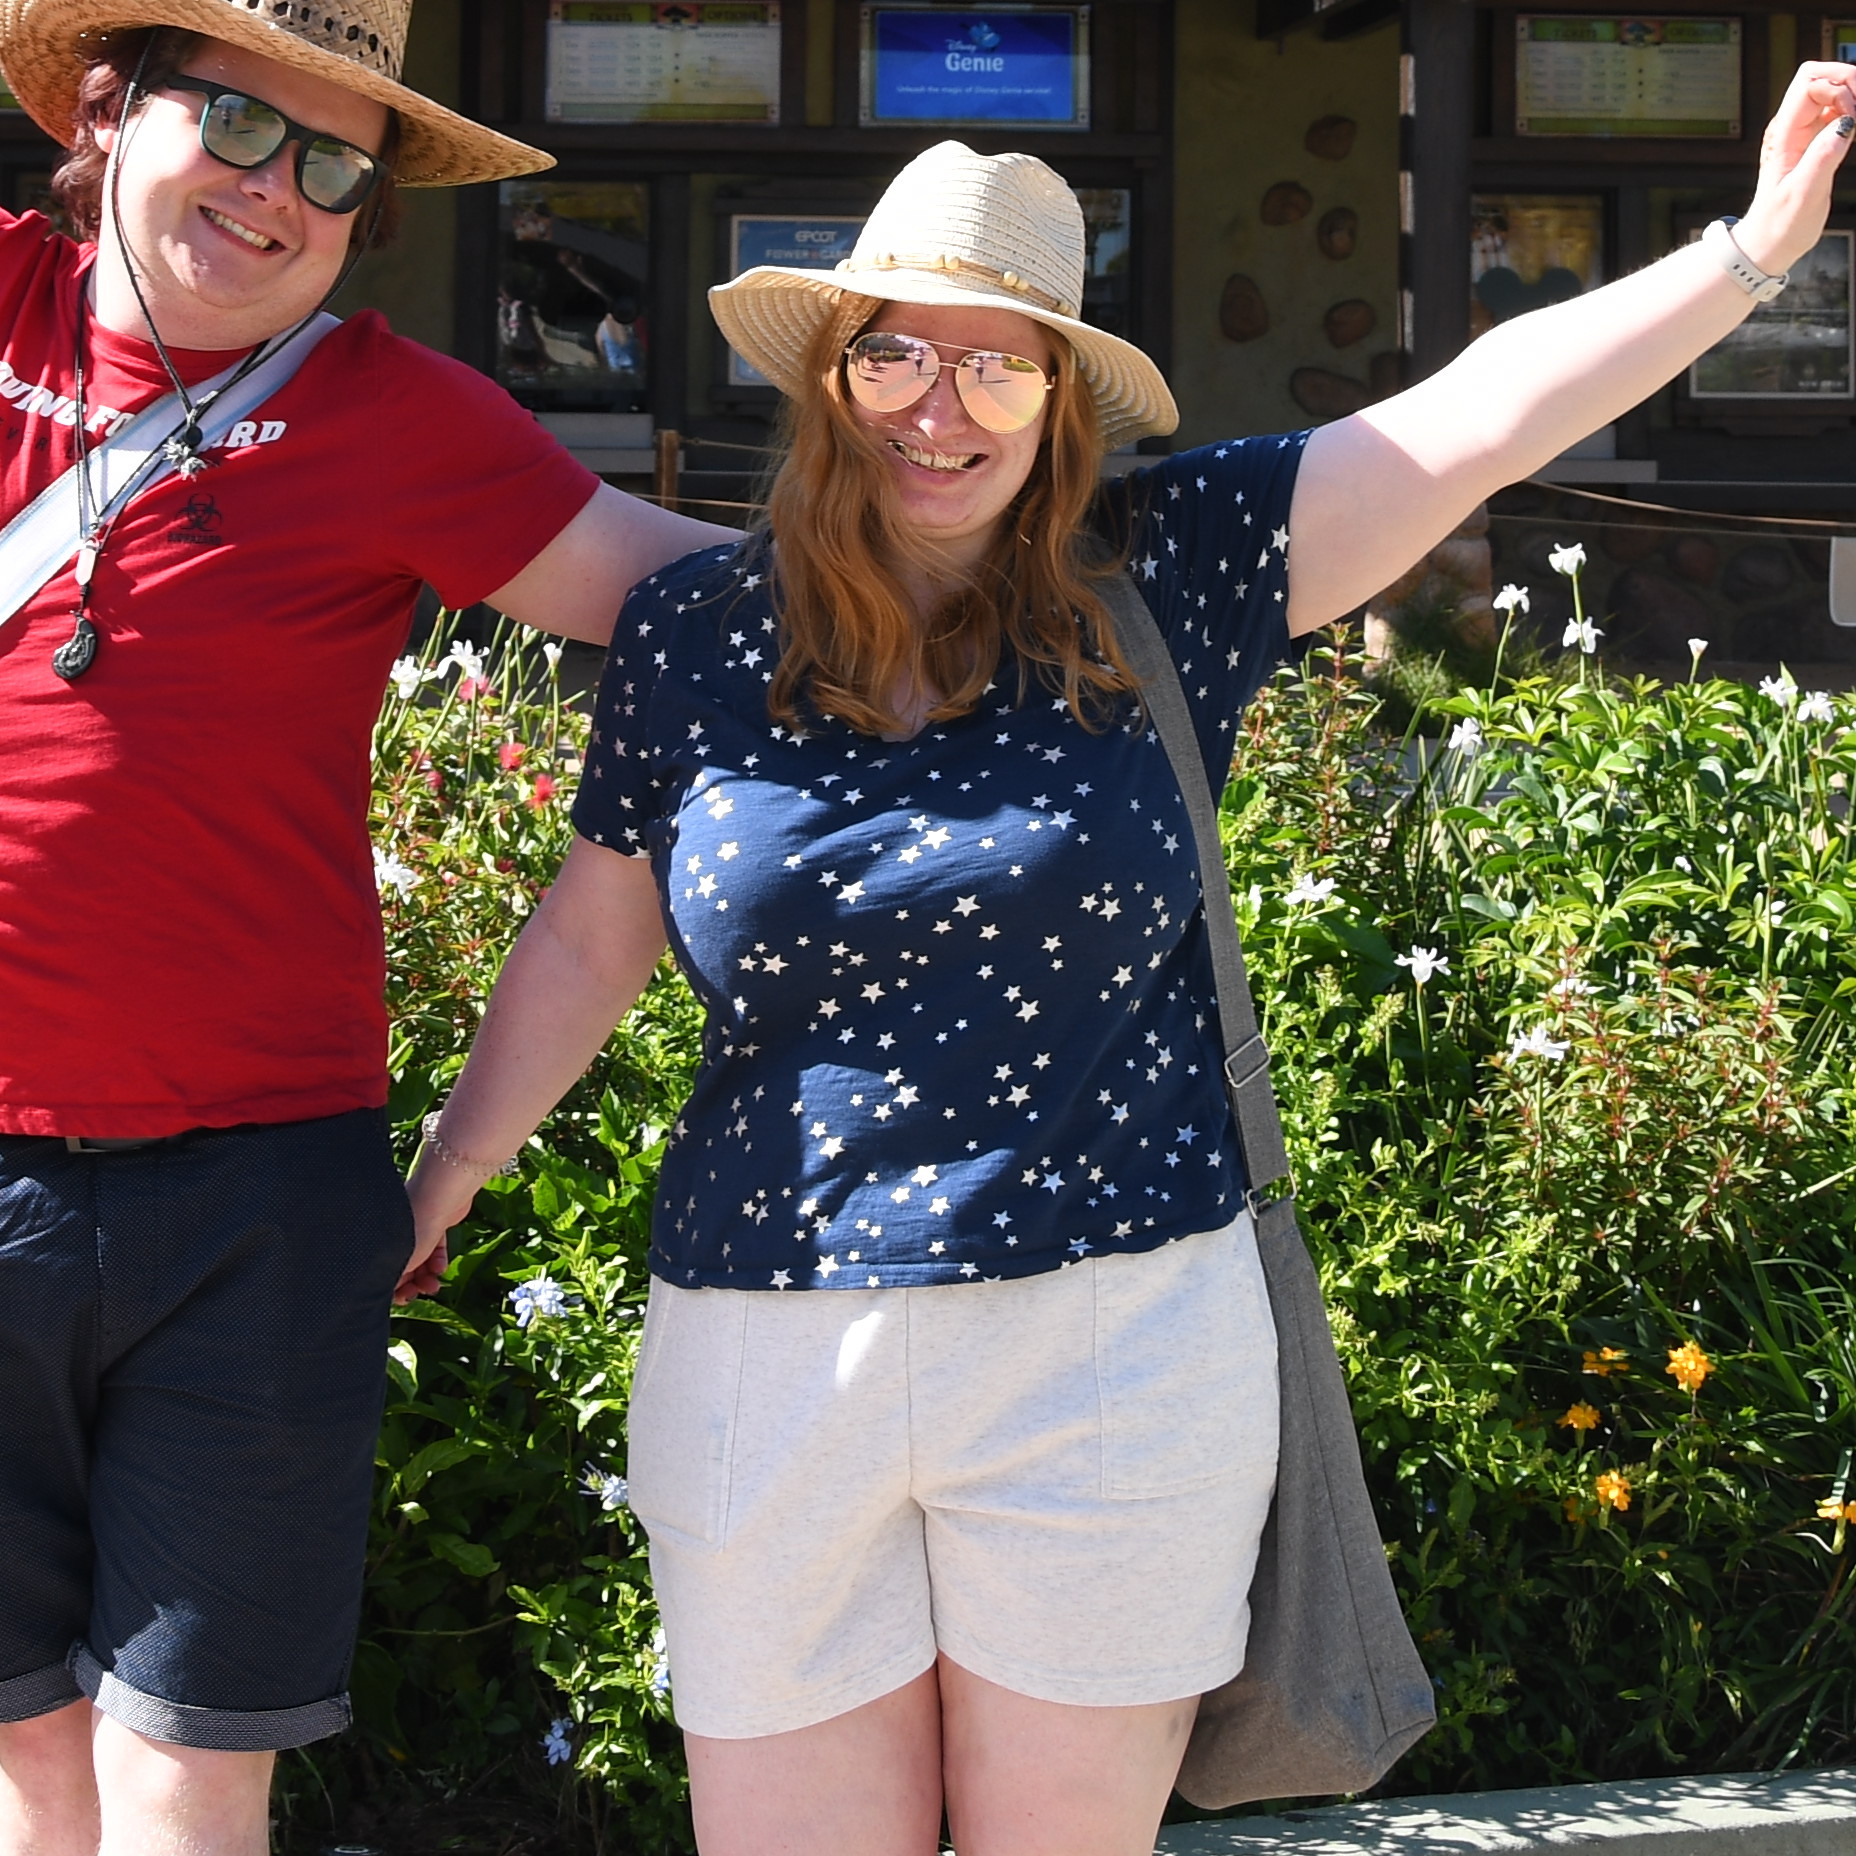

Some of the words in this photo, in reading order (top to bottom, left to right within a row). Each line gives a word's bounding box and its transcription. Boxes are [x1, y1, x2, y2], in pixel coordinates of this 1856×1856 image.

[946, 39, 977, 53] Disney
[945, 52, 1004, 72] Genie
[795, 230, 837, 242] EPCOT
[84, 404, 287, 449] FORD
